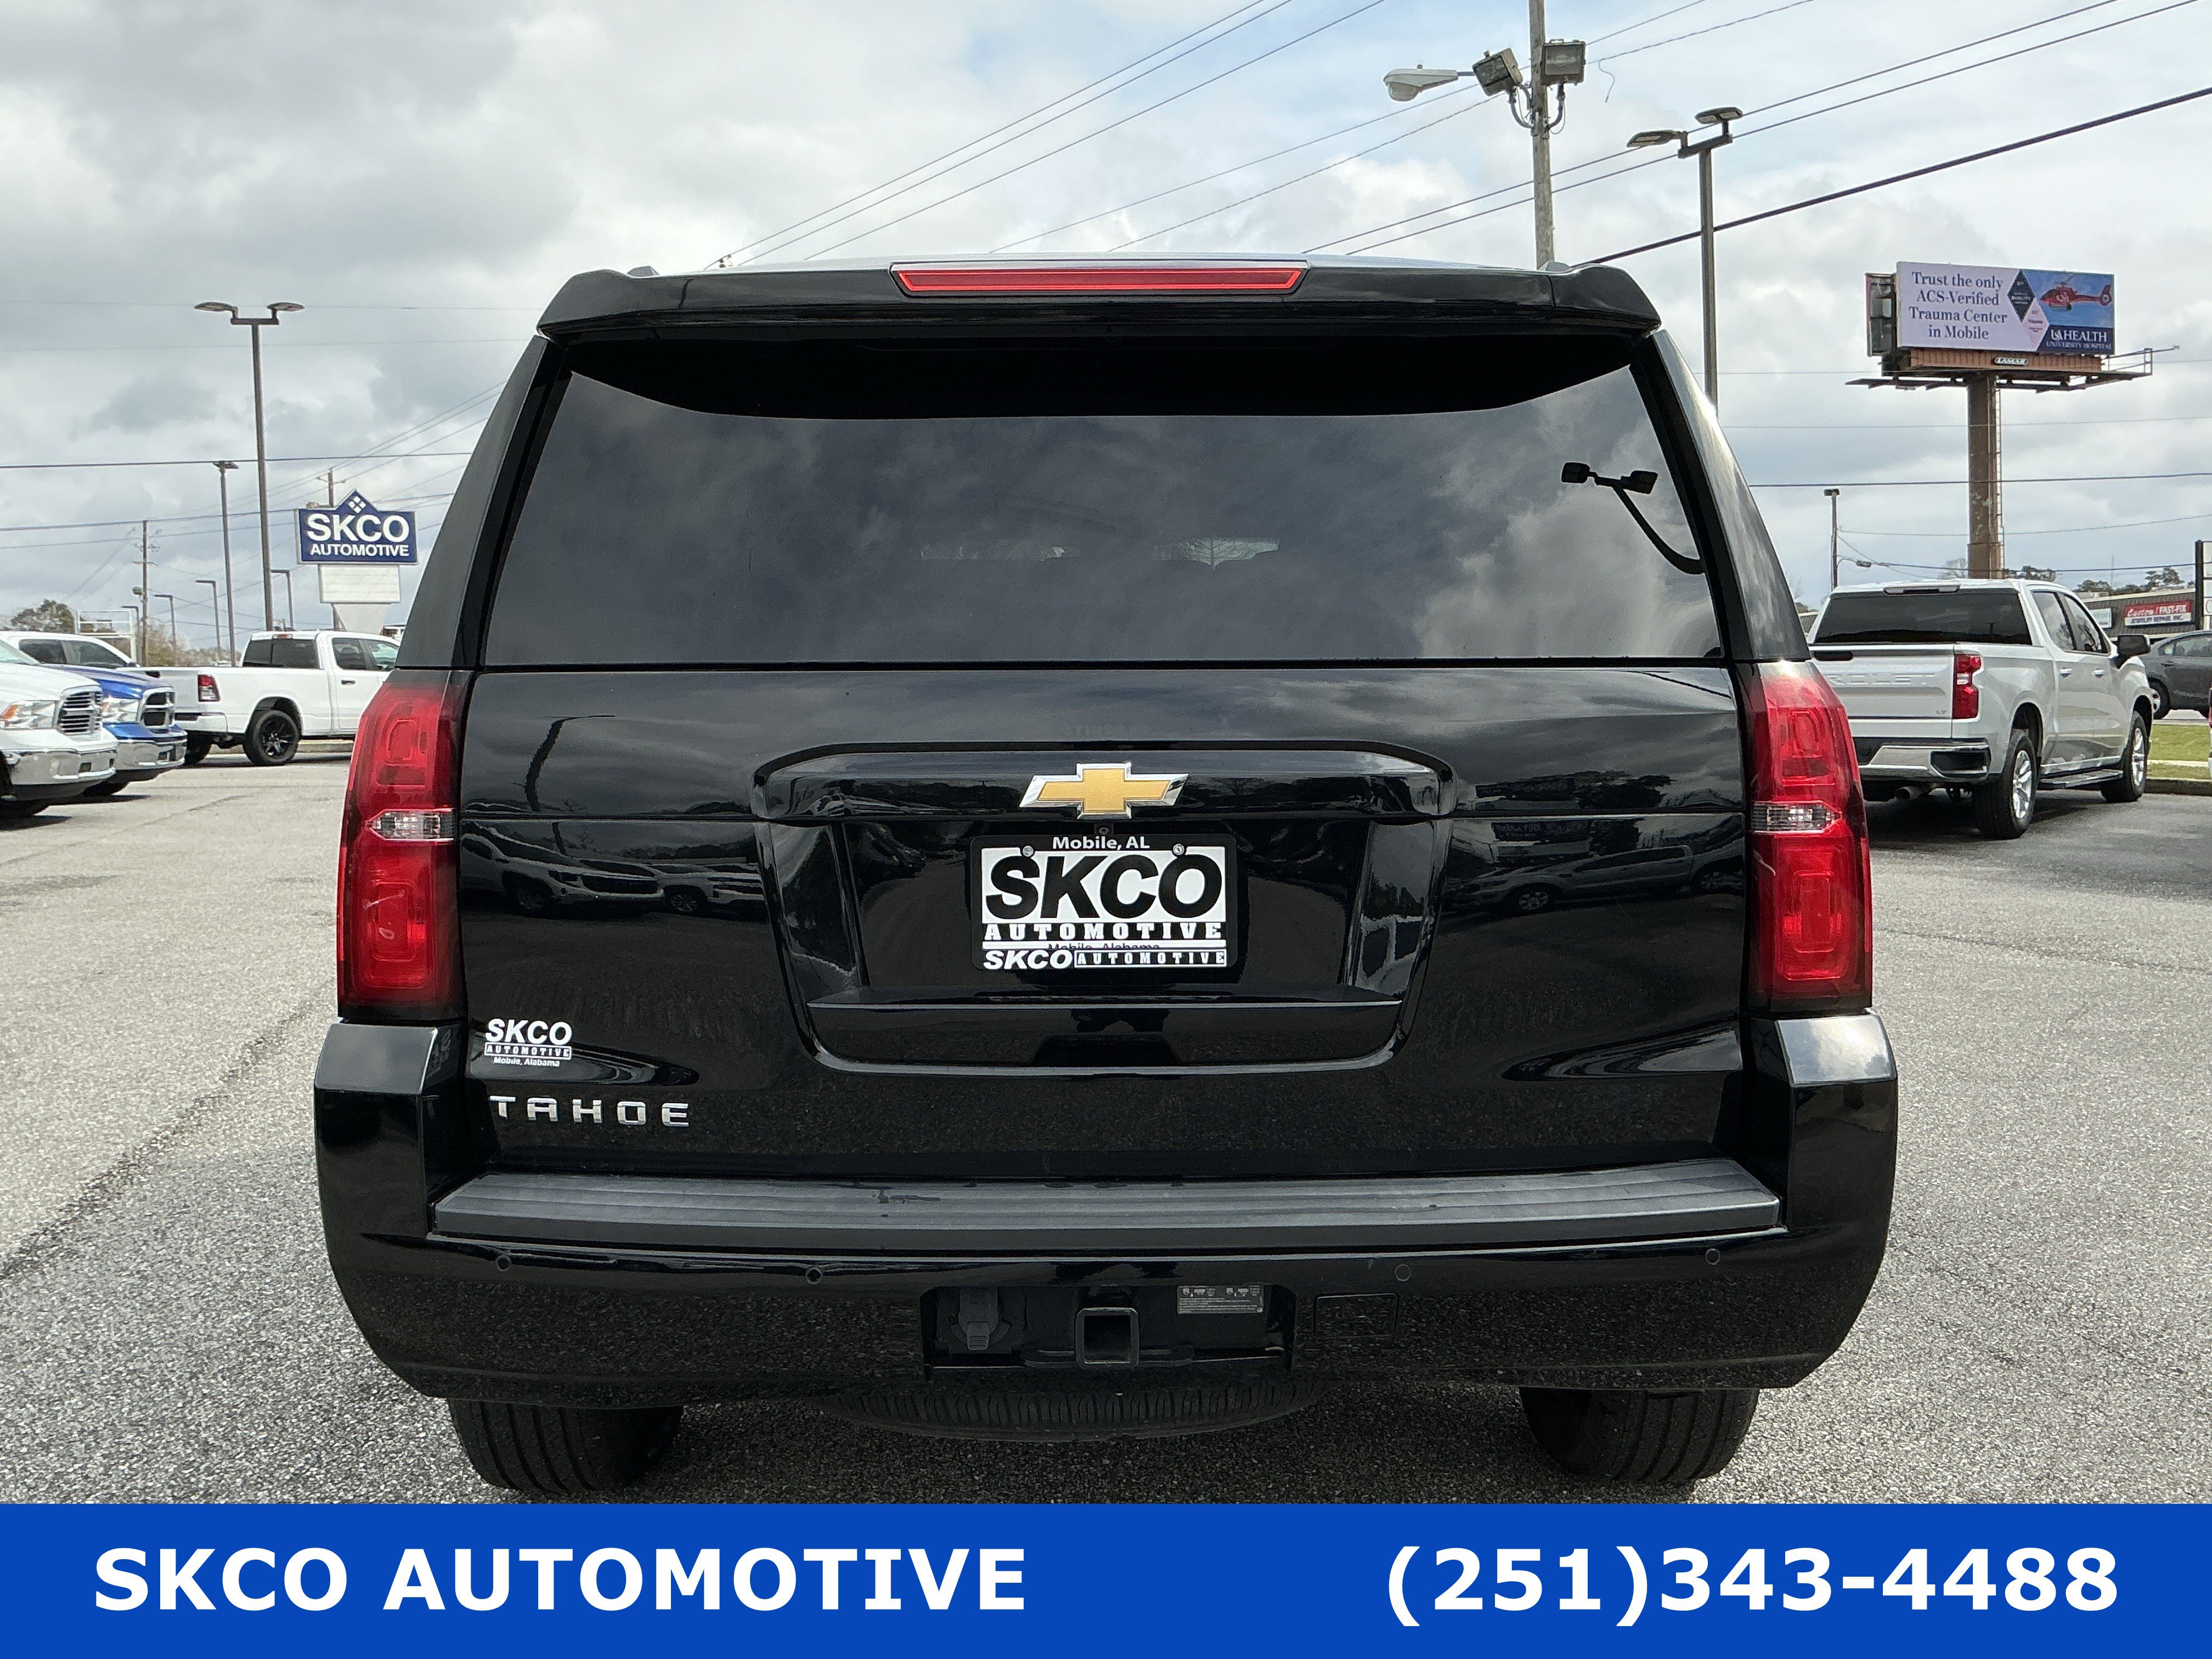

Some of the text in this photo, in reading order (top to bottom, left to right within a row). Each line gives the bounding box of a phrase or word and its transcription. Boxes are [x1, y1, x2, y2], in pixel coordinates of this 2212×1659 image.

[1911, 272, 2004, 291] Trust the only
[1916, 290, 1999, 306] ACS-Verified
[1908, 306, 2008, 323] Trauma Center
[1928, 324, 1989, 339] in Mobile
[2063, 330, 2107, 342] HEALTH
[307, 513, 409, 543] SKCO
[310, 544, 409, 556] AUTOMOTIVE
[1052, 836, 1150, 851] Mobile, AL
[985, 854, 1223, 919] SKCO
[984, 923, 1222, 940] AUTOMOTIVE
[984, 950, 1225, 970] SKCO AUTOMOTIVE
[486, 1018, 572, 1045] SKCO
[486, 1045, 569, 1057] AUTOMOTIVE
[494, 1057, 560, 1067] Mobile, Alabama
[490, 1096, 690, 1127] TAHOE
